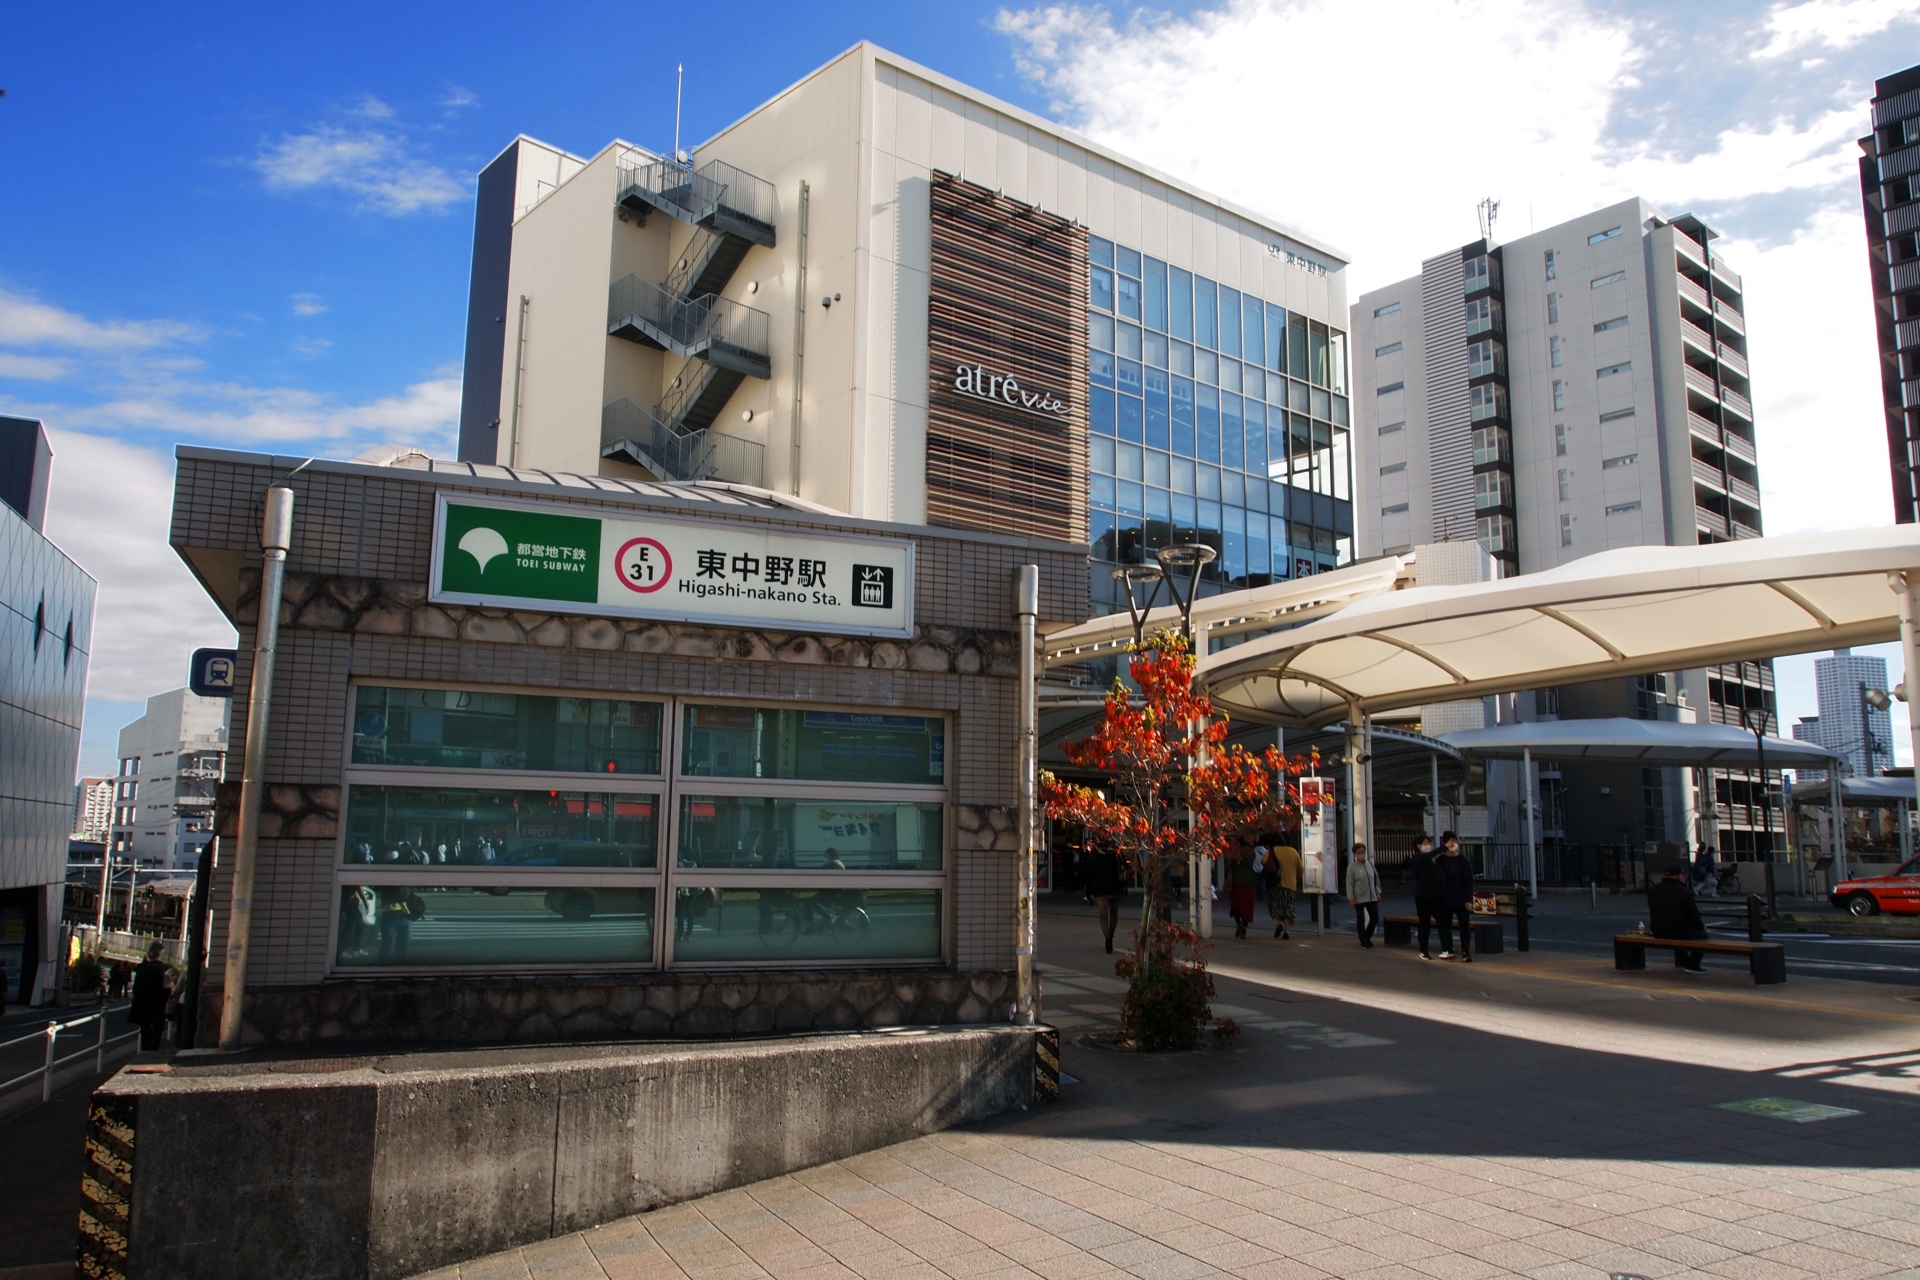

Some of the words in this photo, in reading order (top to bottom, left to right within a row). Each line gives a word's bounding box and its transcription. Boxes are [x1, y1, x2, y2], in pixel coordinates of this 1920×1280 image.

[1268, 244, 1281, 256] JR
[1286, 251, 1327, 279] 東中野駅
[516, 542, 587, 561] 都営地下鉄
[639, 547, 649, 562] E
[516, 557, 539, 569] TOEI
[543, 562, 586, 573] SUBWAY
[629, 563, 654, 581] 31
[695, 549, 827, 589] 東中野駅
[1298, 561, 1311, 579] 本
[678, 579, 807, 604] Higashi-nakano
[812, 591, 841, 606] Sta.
